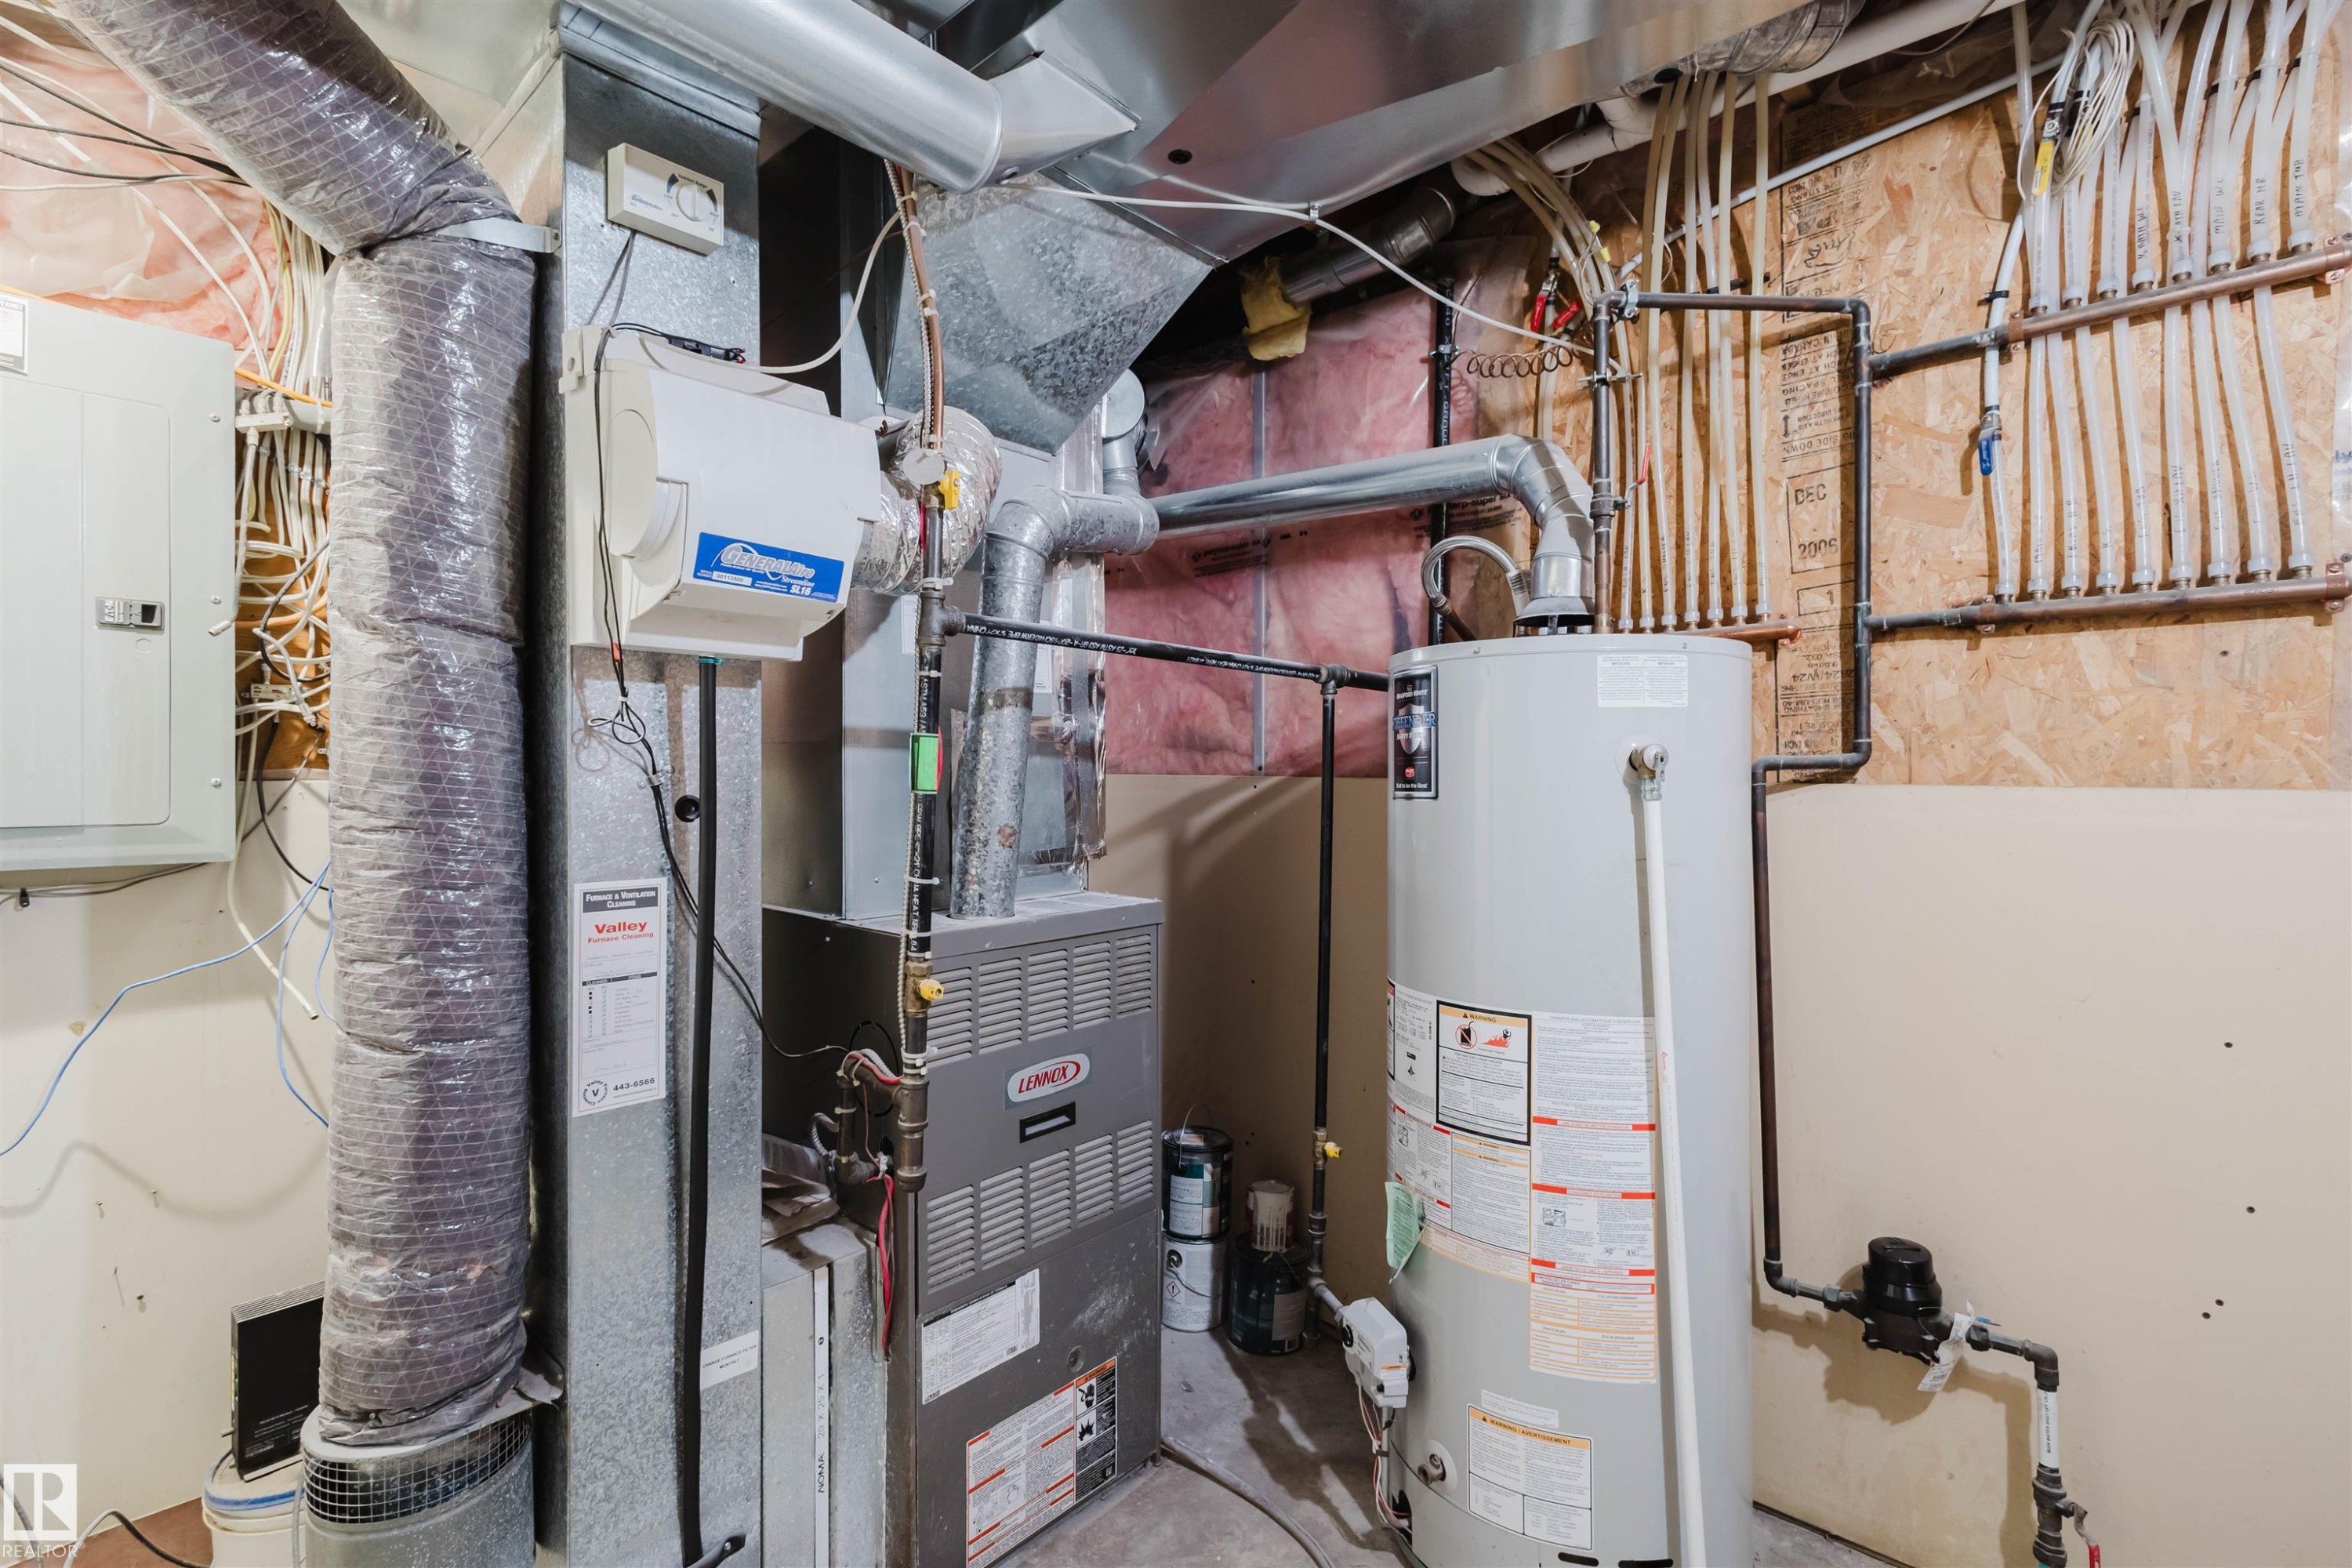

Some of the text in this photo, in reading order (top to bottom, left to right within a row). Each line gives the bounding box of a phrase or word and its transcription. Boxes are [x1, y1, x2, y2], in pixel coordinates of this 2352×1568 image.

[2294, 186, 2304, 217] MAIN
[2213, 206, 2224, 234] MAIN
[2253, 200, 2266, 225] REAR
[2137, 226, 2147, 249] BATH
[1782, 379, 1825, 396] SPACING
[1783, 434, 1838, 454] SIDE DOWN
[1794, 483, 1828, 506] DEC
[1797, 537, 1839, 561] 2006
[781, 575, 815, 587] Streamline
[790, 585, 811, 596] SL16
[1393, 712, 1436, 730] DEFENDER
[595, 922, 648, 934] Valley
[1469, 1014, 1496, 1022] WARNING
[613, 1078, 655, 1091] 443-6566
[1018, 1064, 1071, 1094] LENNOX
[702, 1358, 720, 1368] CHANGE
[722, 1351, 741, 1361] FURNACE
[720, 1359, 739, 1369] MONTHLY
[818, 1396, 825, 1408] 25
[818, 1426, 825, 1438] 20
[1490, 1419, 1517, 1432] WARNING
[1522, 1429, 1571, 1445] AVERTISSEMENT
